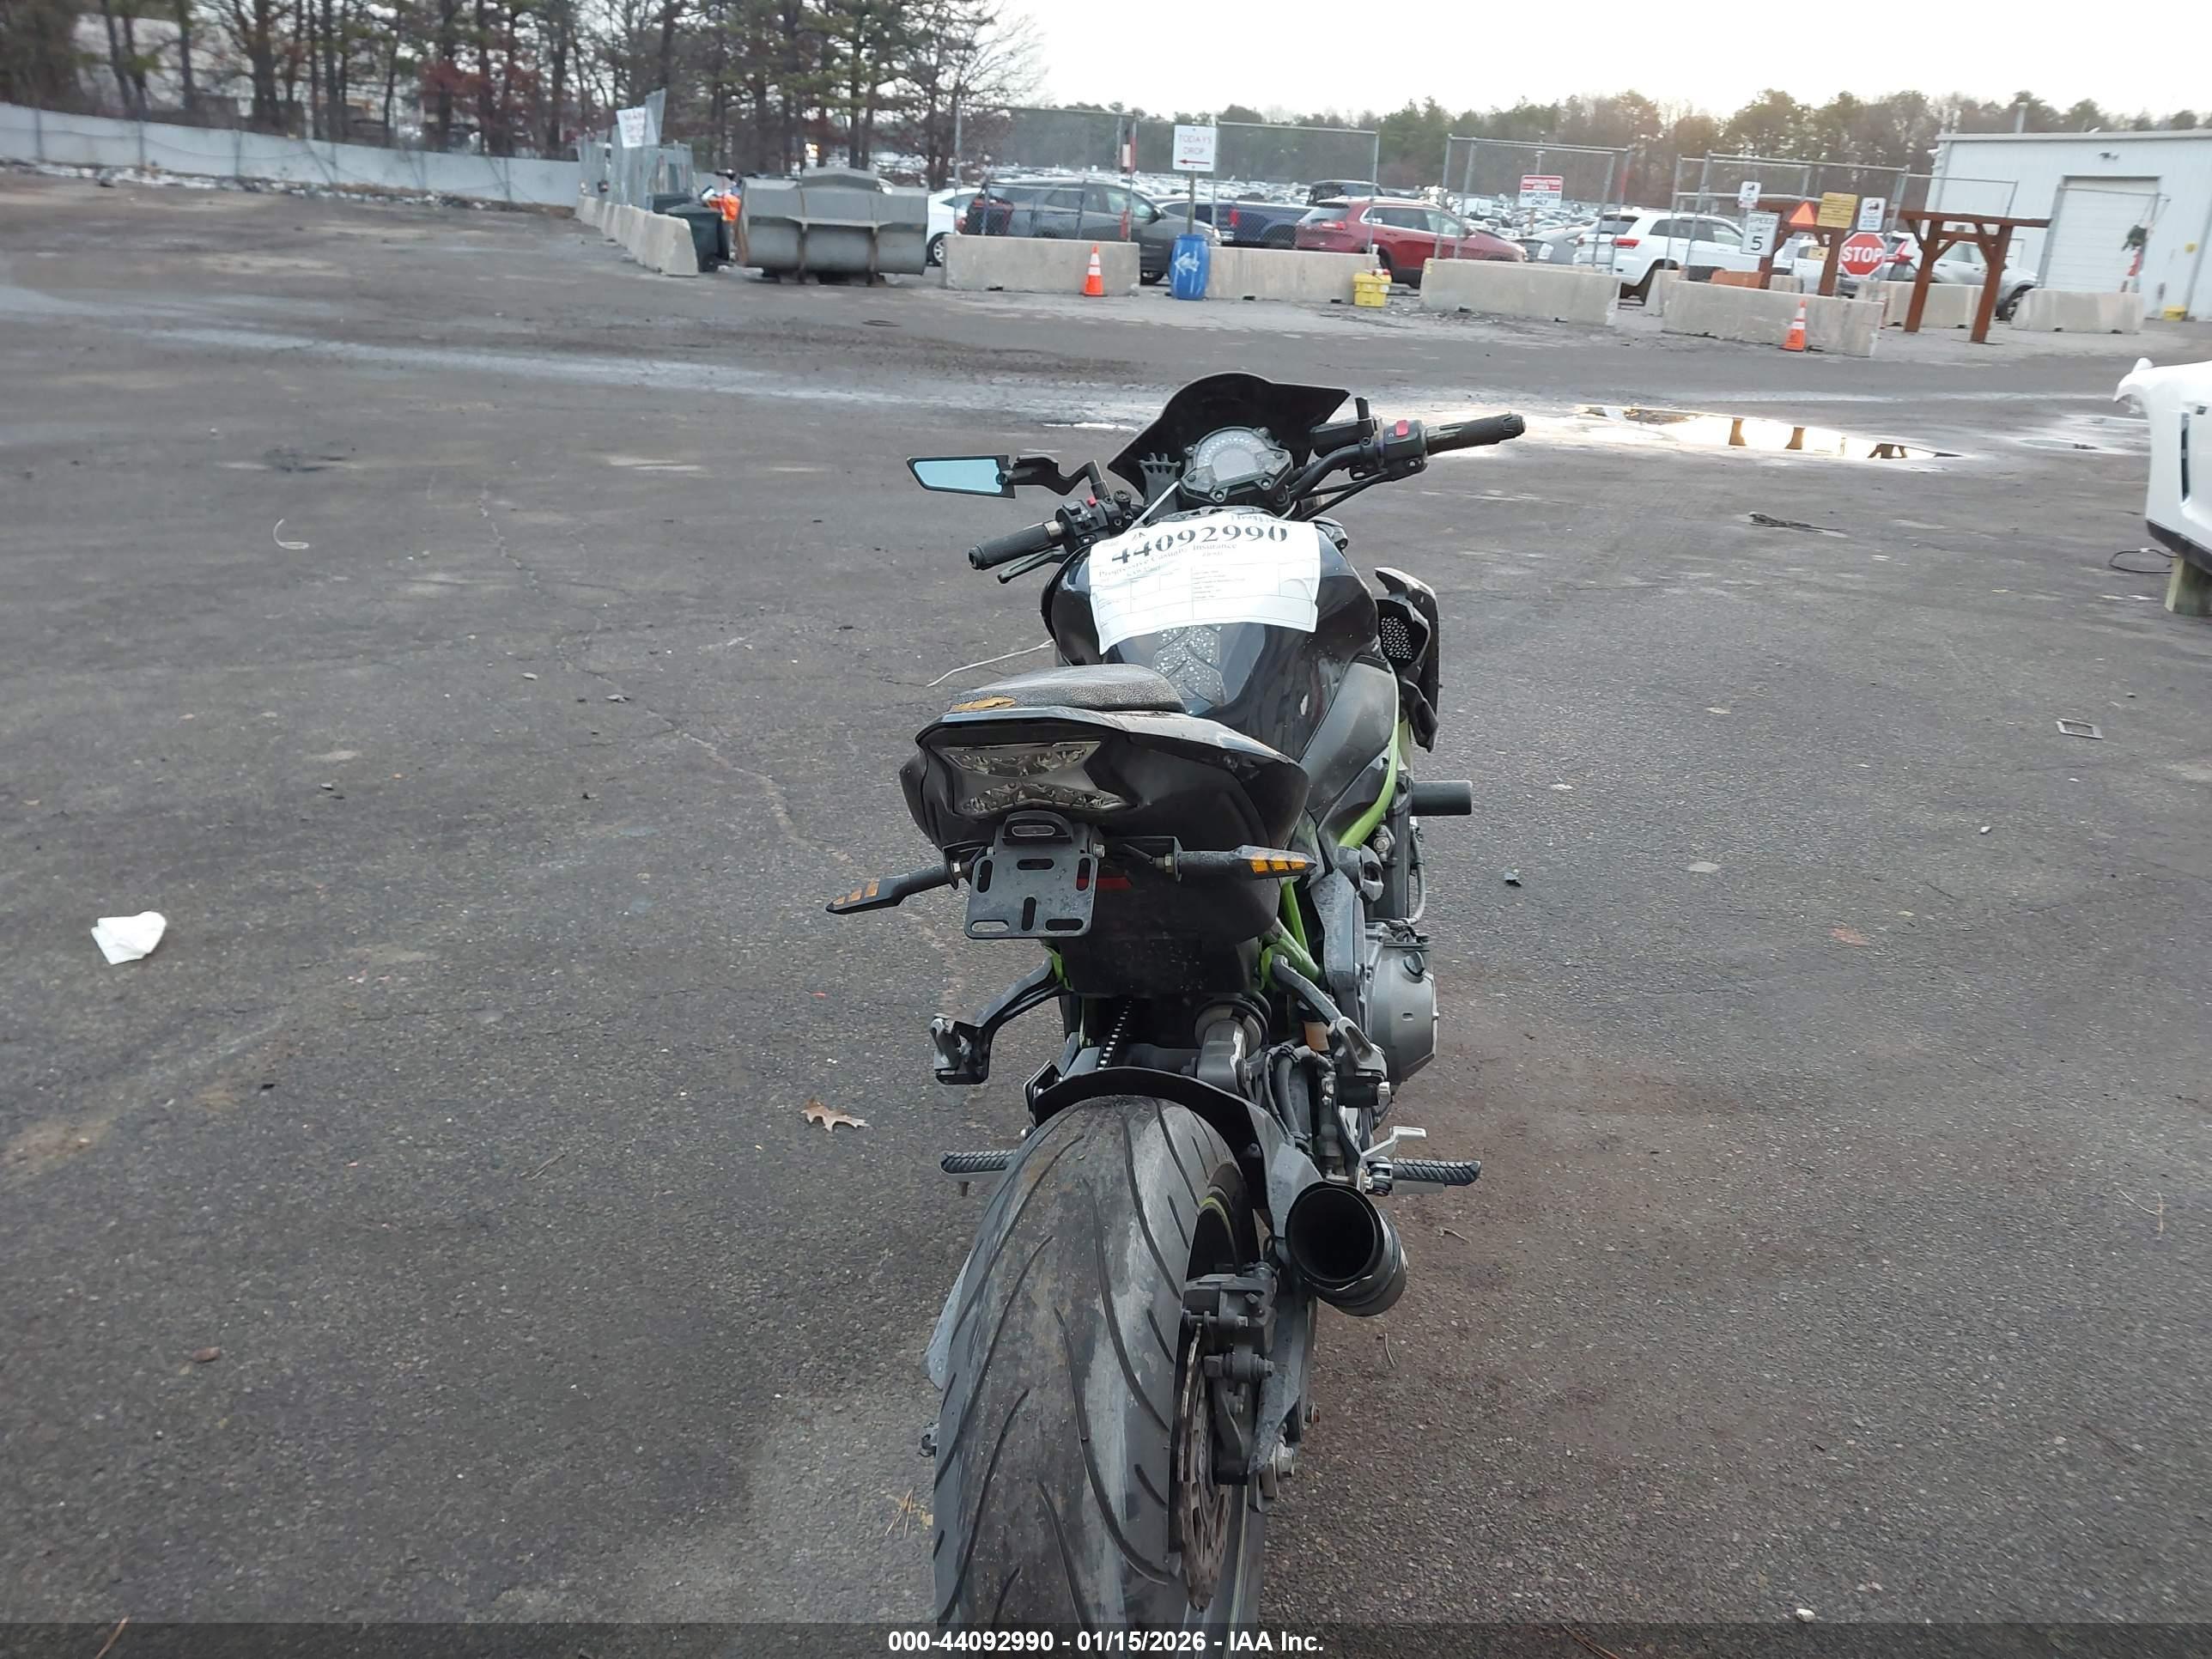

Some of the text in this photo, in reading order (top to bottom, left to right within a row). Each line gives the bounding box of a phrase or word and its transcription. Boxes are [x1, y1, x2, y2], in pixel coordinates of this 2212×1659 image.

[1750, 236, 1763, 251] 5
[1842, 246, 1883, 263] STOP
[1112, 525, 1287, 564] 44092990
